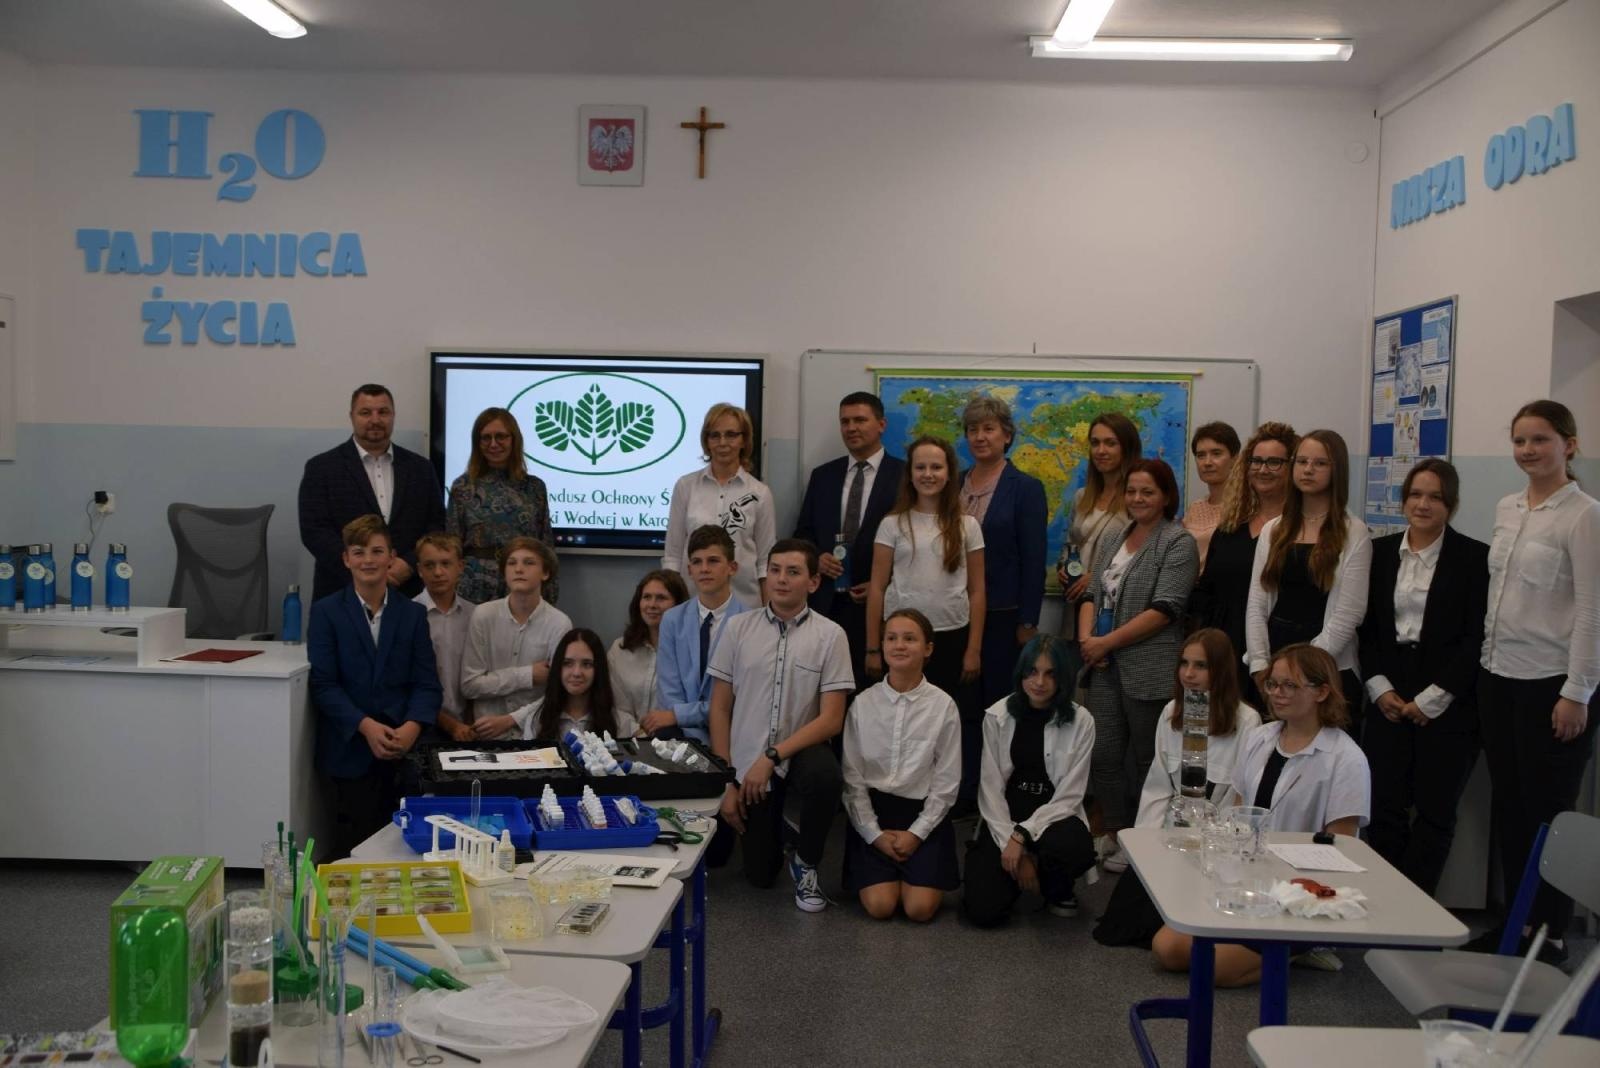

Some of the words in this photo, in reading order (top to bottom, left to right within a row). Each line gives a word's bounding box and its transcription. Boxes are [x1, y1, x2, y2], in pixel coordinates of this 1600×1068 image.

[1391, 155, 1466, 230] NASZA
[1484, 103, 1576, 191] ODRA
[76, 228, 367, 277] TAJEMNICA
[141, 285, 296, 345] ŻYCIA
[549, 487, 587, 504] ndusz
[660, 487, 671, 506] Ś
